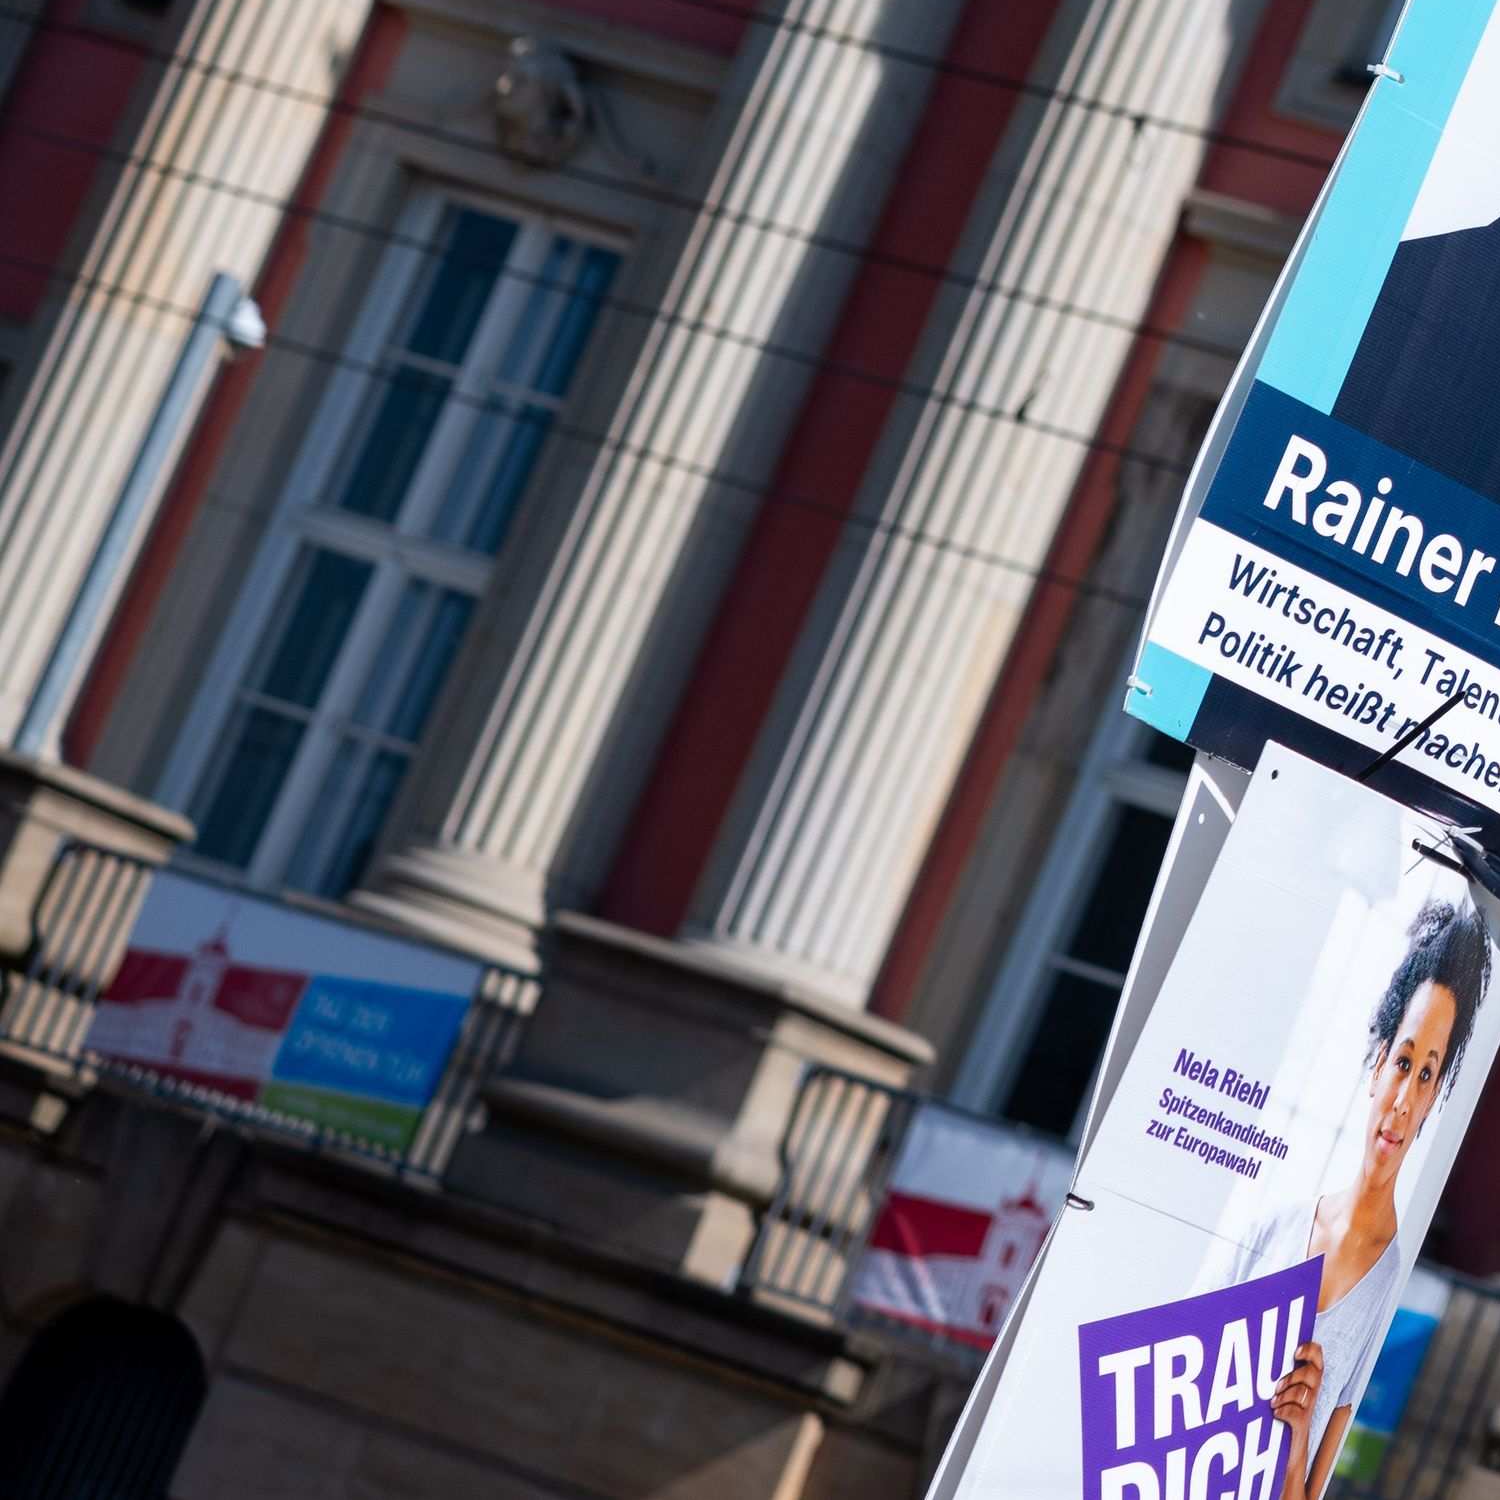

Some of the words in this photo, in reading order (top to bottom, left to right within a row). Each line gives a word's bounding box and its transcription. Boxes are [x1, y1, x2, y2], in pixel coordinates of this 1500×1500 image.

[1263, 433, 1496, 606] Rainer
[1198, 611, 1303, 688] Politik
[1302, 663, 1396, 733] heißt
[1228, 553, 1404, 680] Wirtschaft,
[1158, 1087, 1289, 1161] Spitzenkandidatin
[1172, 1047, 1220, 1090] Nela
[1218, 1067, 1271, 1111] Riehl
[1145, 1119, 1176, 1142] zur
[1173, 1126, 1262, 1180] Europawahl
[1098, 1295, 1305, 1451] TRAU
